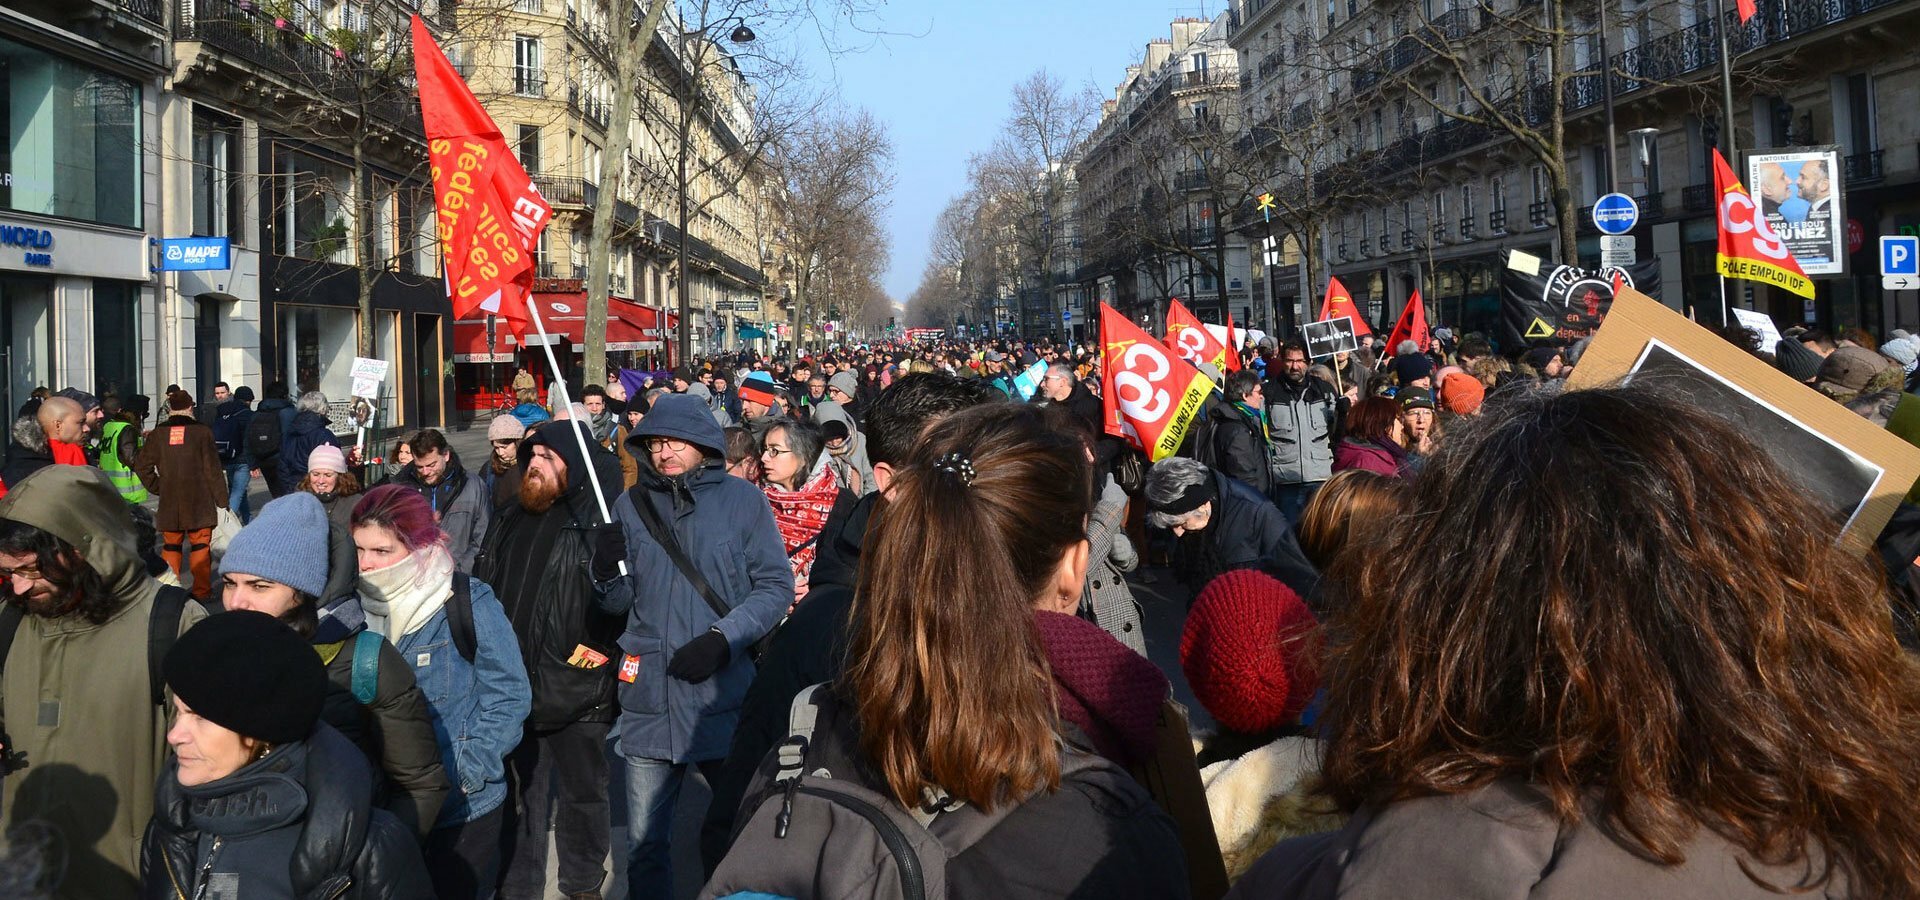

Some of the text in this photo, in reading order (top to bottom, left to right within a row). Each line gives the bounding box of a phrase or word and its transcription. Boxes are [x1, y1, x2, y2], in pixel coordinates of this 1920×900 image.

[1771, 222, 1787, 230] PAR
[1795, 227, 1826, 240] NEZ
[0, 225, 52, 249] WORLD
[185, 246, 221, 258] MAPEI
[1891, 245, 1908, 268] P
[1750, 264, 1787, 285] EMPLOI
[1789, 276, 1805, 290] IDF
[1567, 314, 1580, 322] en
[1556, 327, 1587, 343] depuis
[623, 660, 640, 677] cgt
